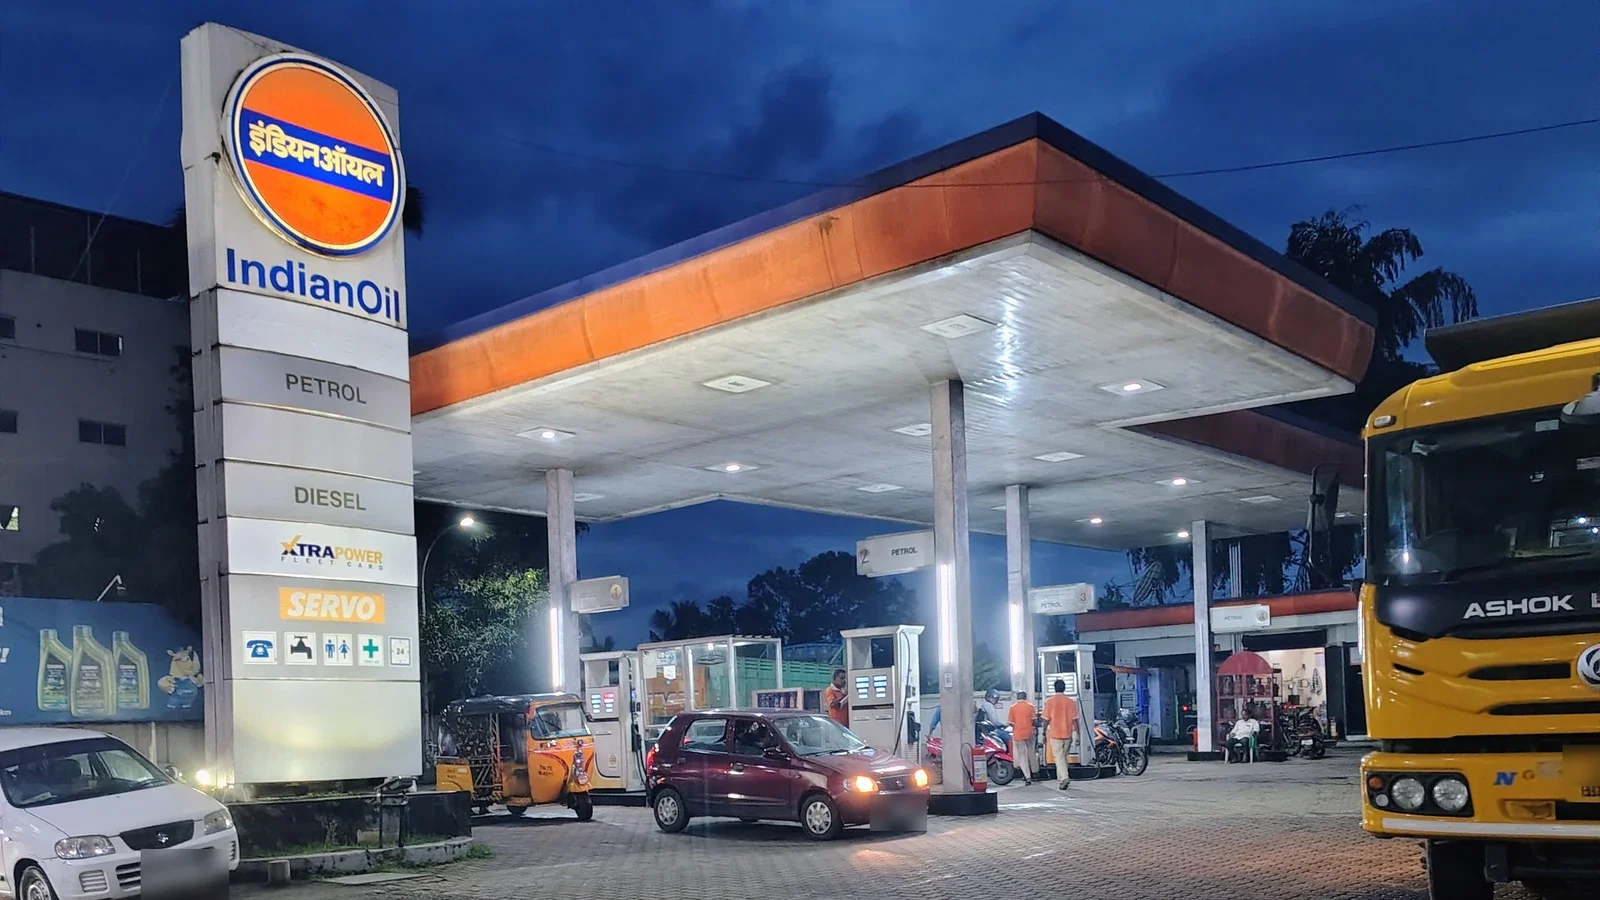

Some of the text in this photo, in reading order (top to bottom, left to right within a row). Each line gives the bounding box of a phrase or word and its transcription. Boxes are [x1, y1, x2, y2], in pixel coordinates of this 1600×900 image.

[249, 120, 385, 187] इंडियनऑयल
[226, 248, 400, 322] IndianOil
[285, 373, 367, 405] PETROL
[294, 486, 366, 511] DIESEL
[281, 535, 383, 564] XTRAPOWER
[860, 548, 870, 564] 2
[891, 546, 918, 556] PETROL
[281, 556, 383, 571] FLEET CARD
[287, 591, 376, 620] SERVO
[1080, 592, 1087, 602] 3
[1463, 594, 1574, 619] ASHOK
[396, 647, 405, 655] 24
